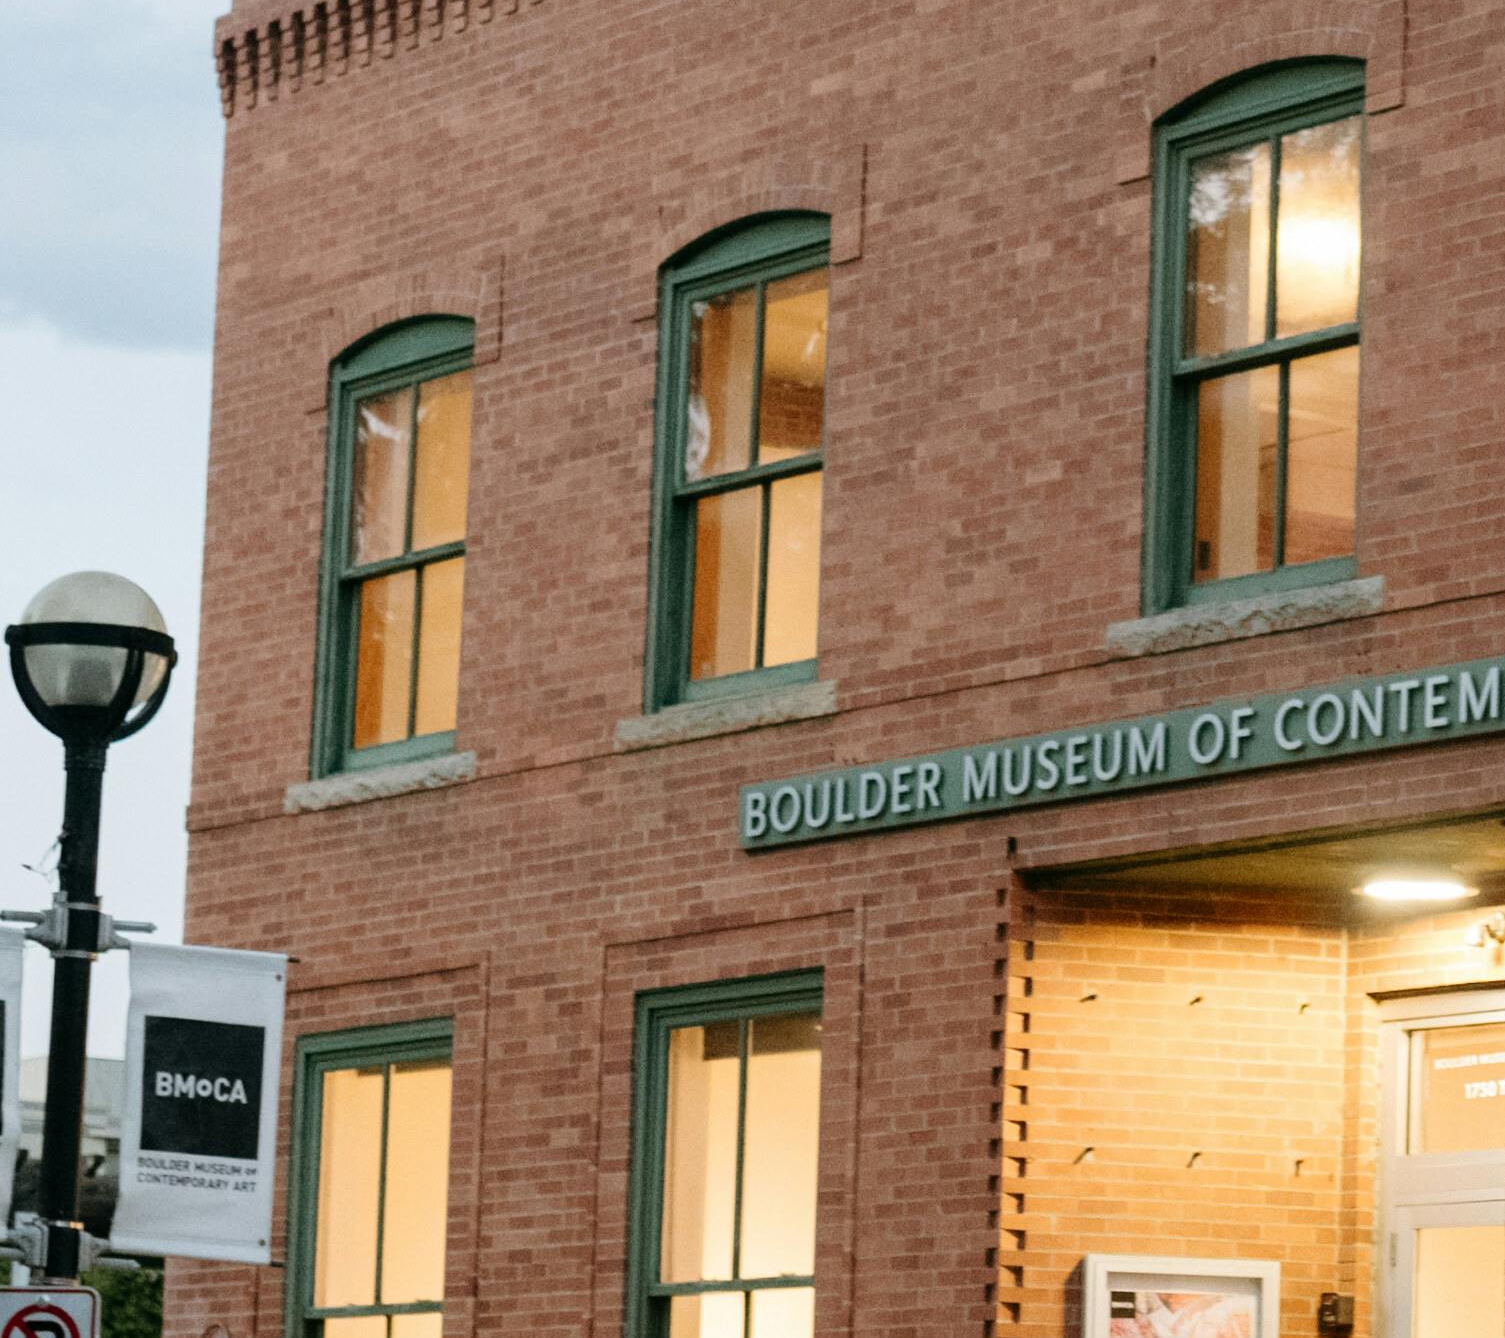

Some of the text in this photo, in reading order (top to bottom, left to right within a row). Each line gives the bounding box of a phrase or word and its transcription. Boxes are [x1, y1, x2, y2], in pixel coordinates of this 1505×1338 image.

[744, 761, 944, 838] BOULDER
[962, 721, 1167, 803] MUSEUM
[1187, 706, 1255, 765] OF
[137, 1156, 189, 1171] BOULDER
[193, 1162, 241, 1175] MUSEUM
[137, 1172, 256, 1191] CONTEMPORARY ART
